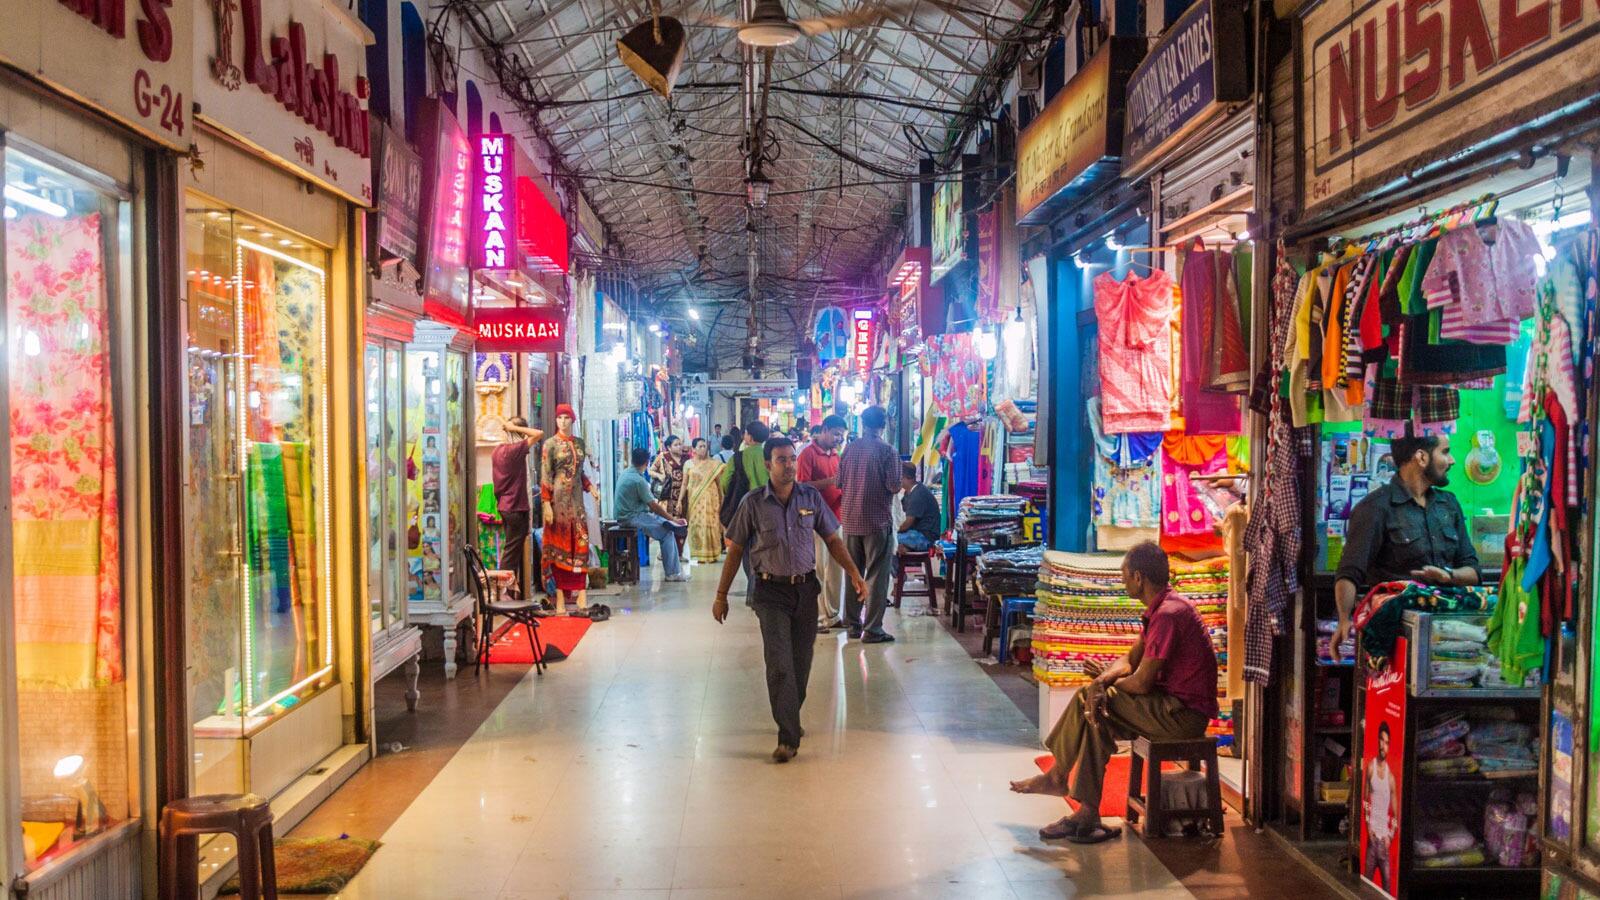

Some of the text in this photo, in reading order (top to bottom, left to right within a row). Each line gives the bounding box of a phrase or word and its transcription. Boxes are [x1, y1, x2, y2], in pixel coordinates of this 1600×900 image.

[1177, 12, 1211, 82] STORES
[134, 69, 184, 137] G-24
[481, 137, 506, 267] MUSKAAN
[479, 321, 560, 339] MUSKAAN
